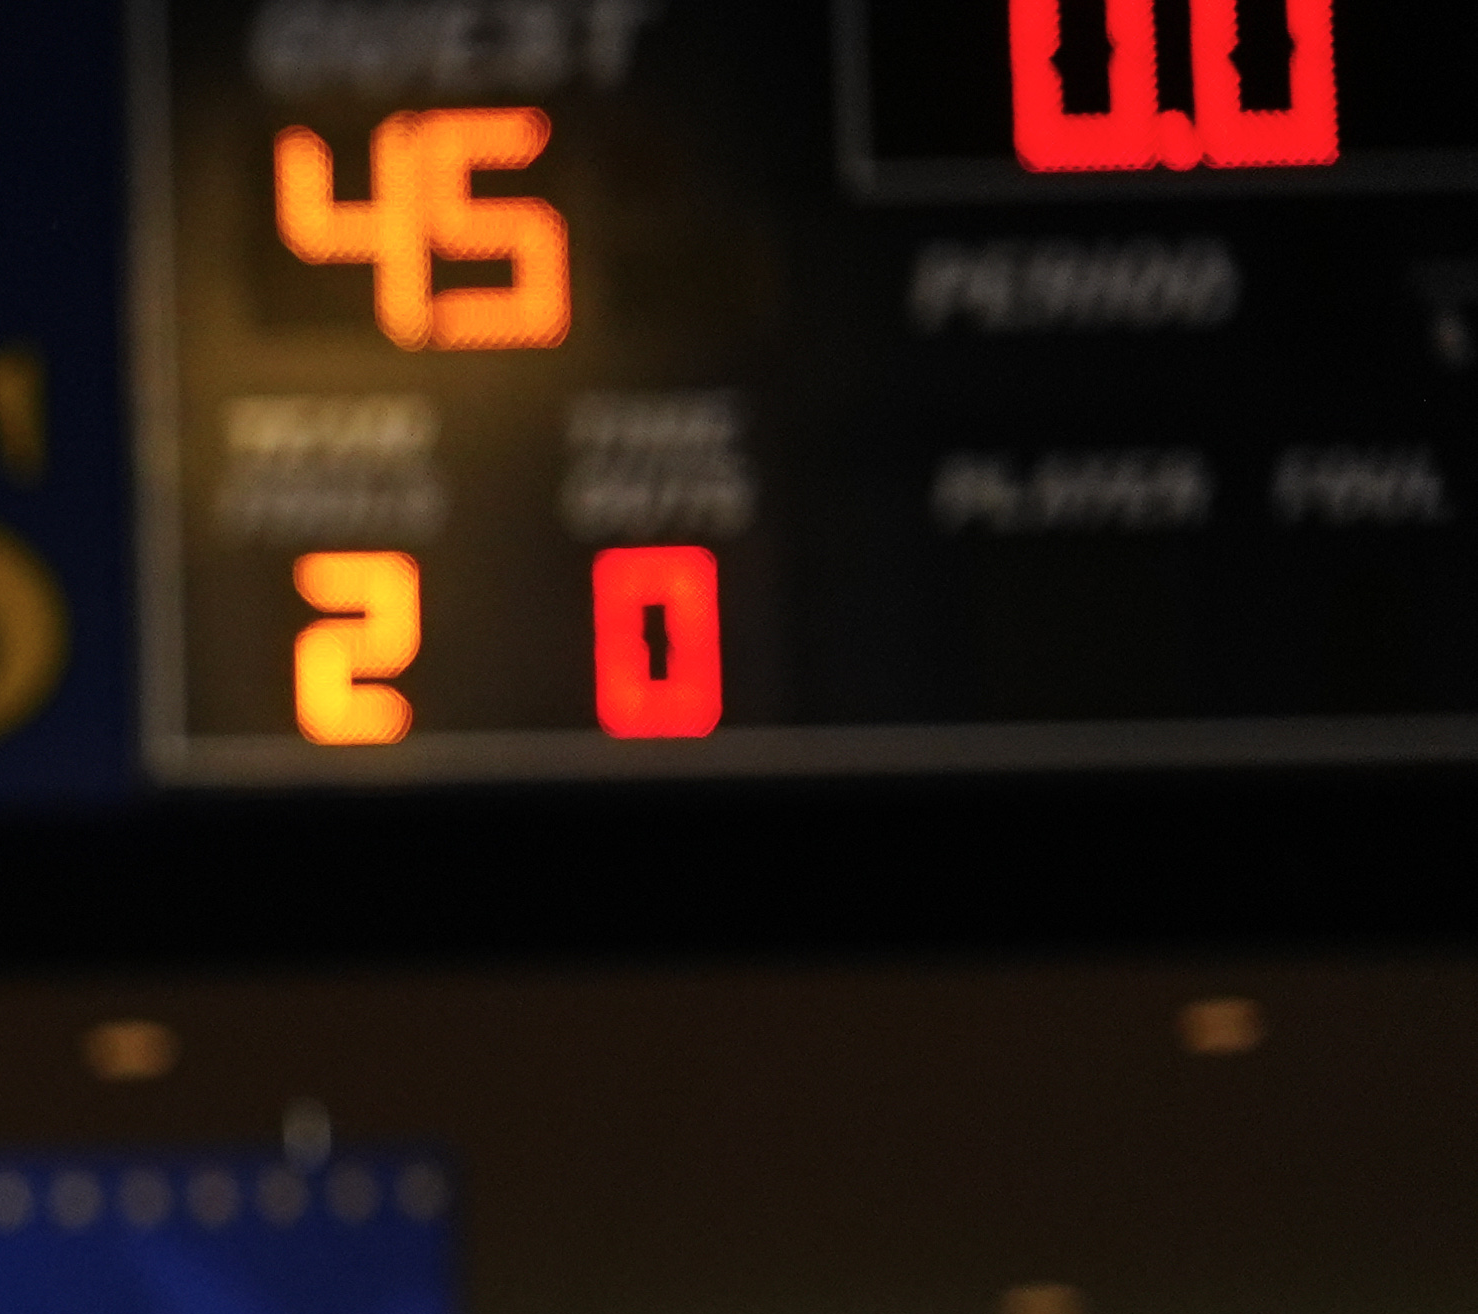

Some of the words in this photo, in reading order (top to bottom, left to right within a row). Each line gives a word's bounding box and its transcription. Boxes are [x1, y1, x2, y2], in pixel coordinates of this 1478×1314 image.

[274, 107, 572, 350] 45
[909, 241, 1234, 330] PERIOD
[931, 451, 1214, 522] PLAYER
[293, 550, 422, 746] 2
[592, 545, 724, 740] 0
